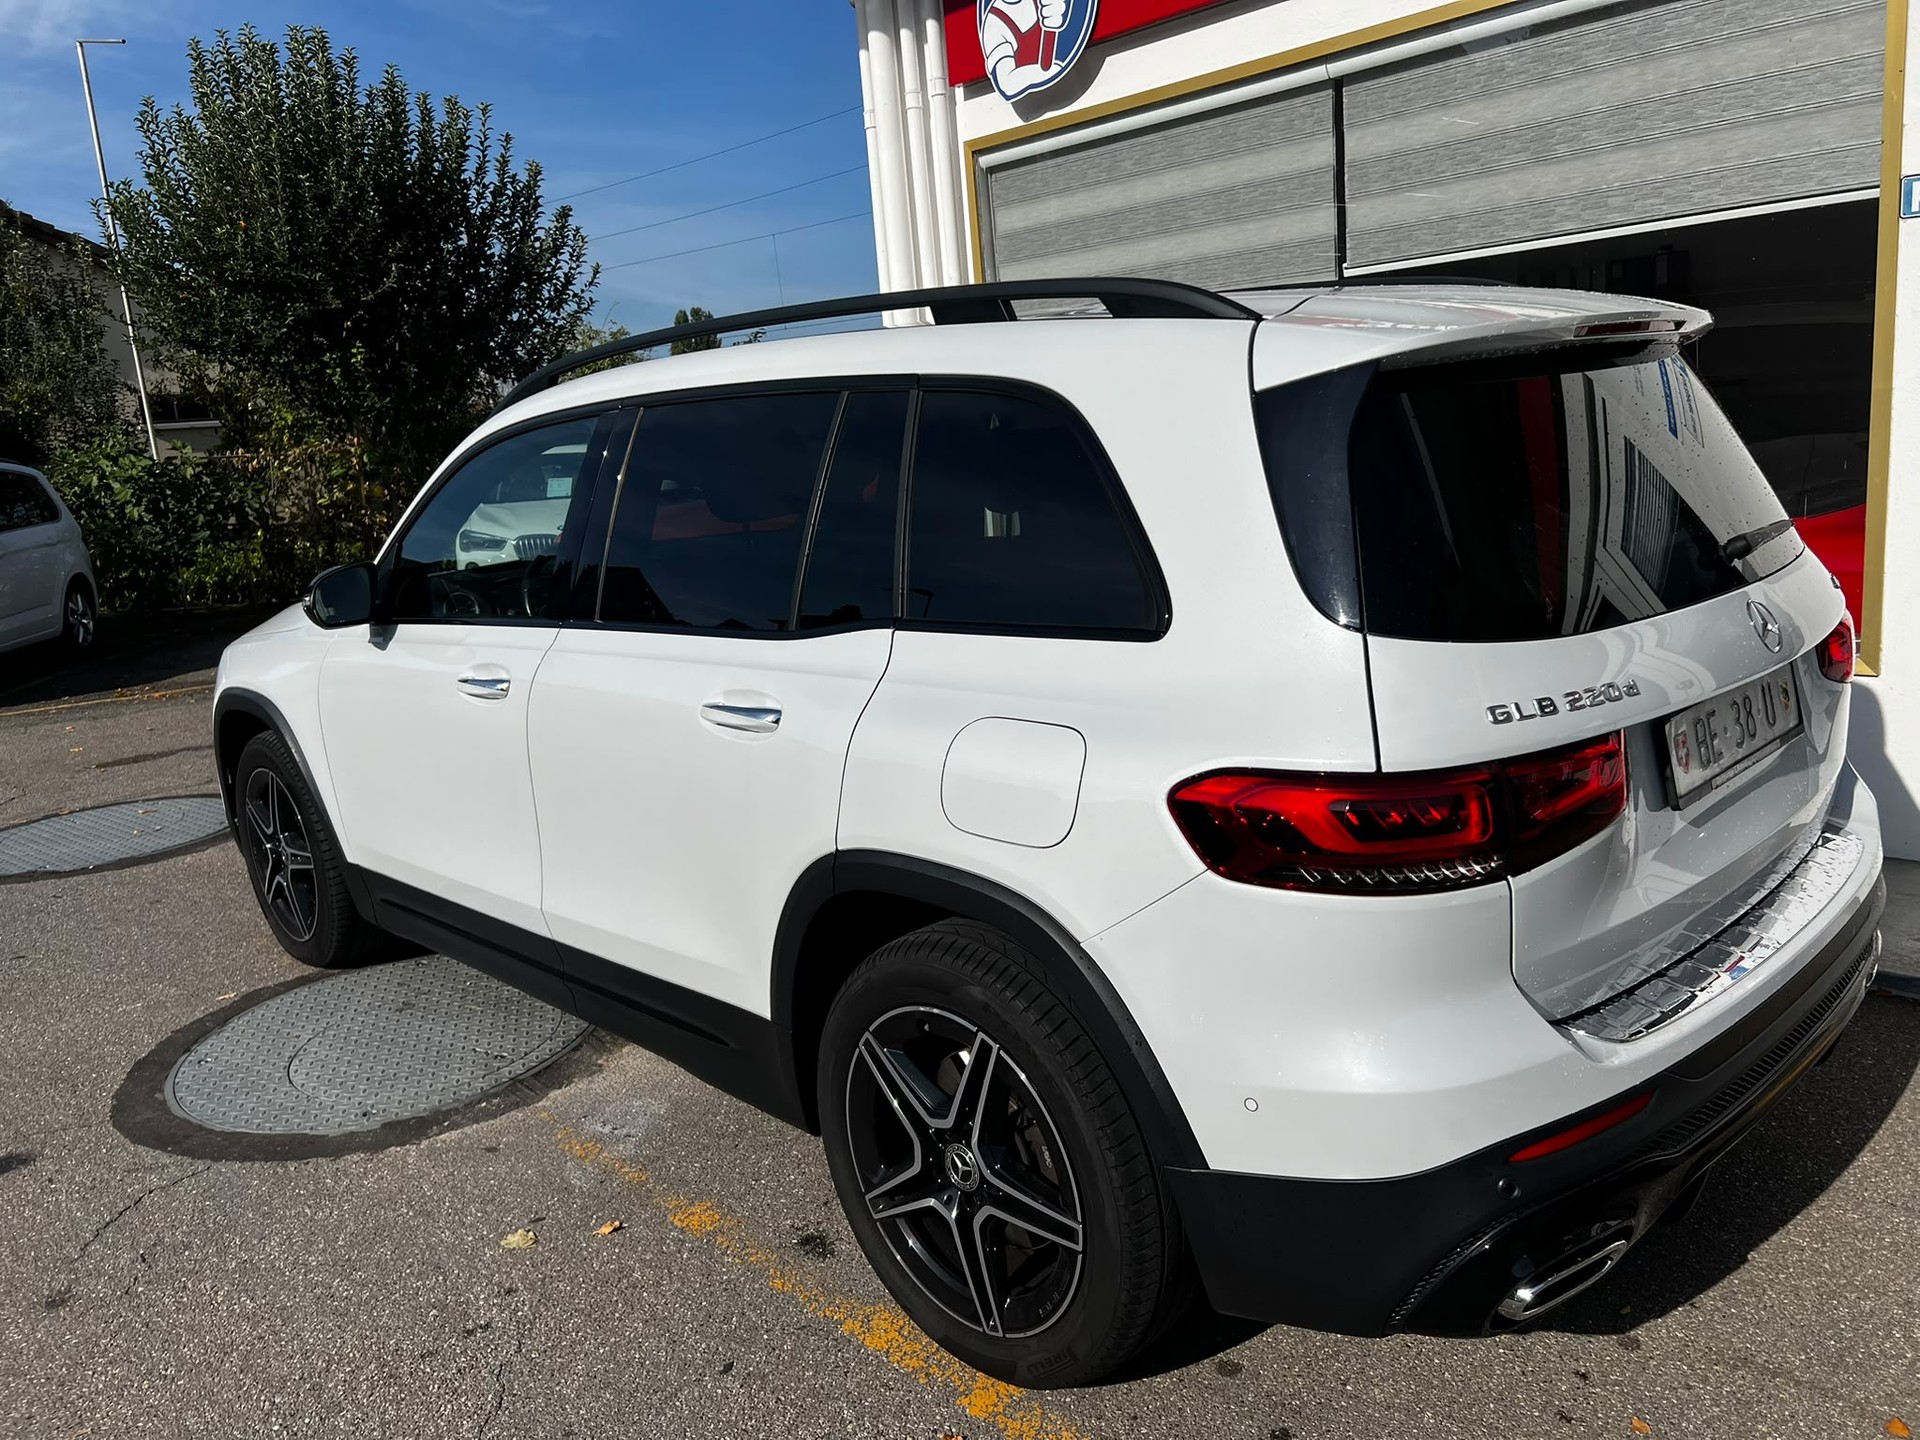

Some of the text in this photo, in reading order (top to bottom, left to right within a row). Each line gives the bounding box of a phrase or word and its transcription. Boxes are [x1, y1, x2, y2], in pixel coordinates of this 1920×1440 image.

[1485, 696, 1560, 725] GLB
[1694, 708, 1726, 773] BE
[1728, 691, 1758, 751] 38
[1760, 679, 1777, 730] U
